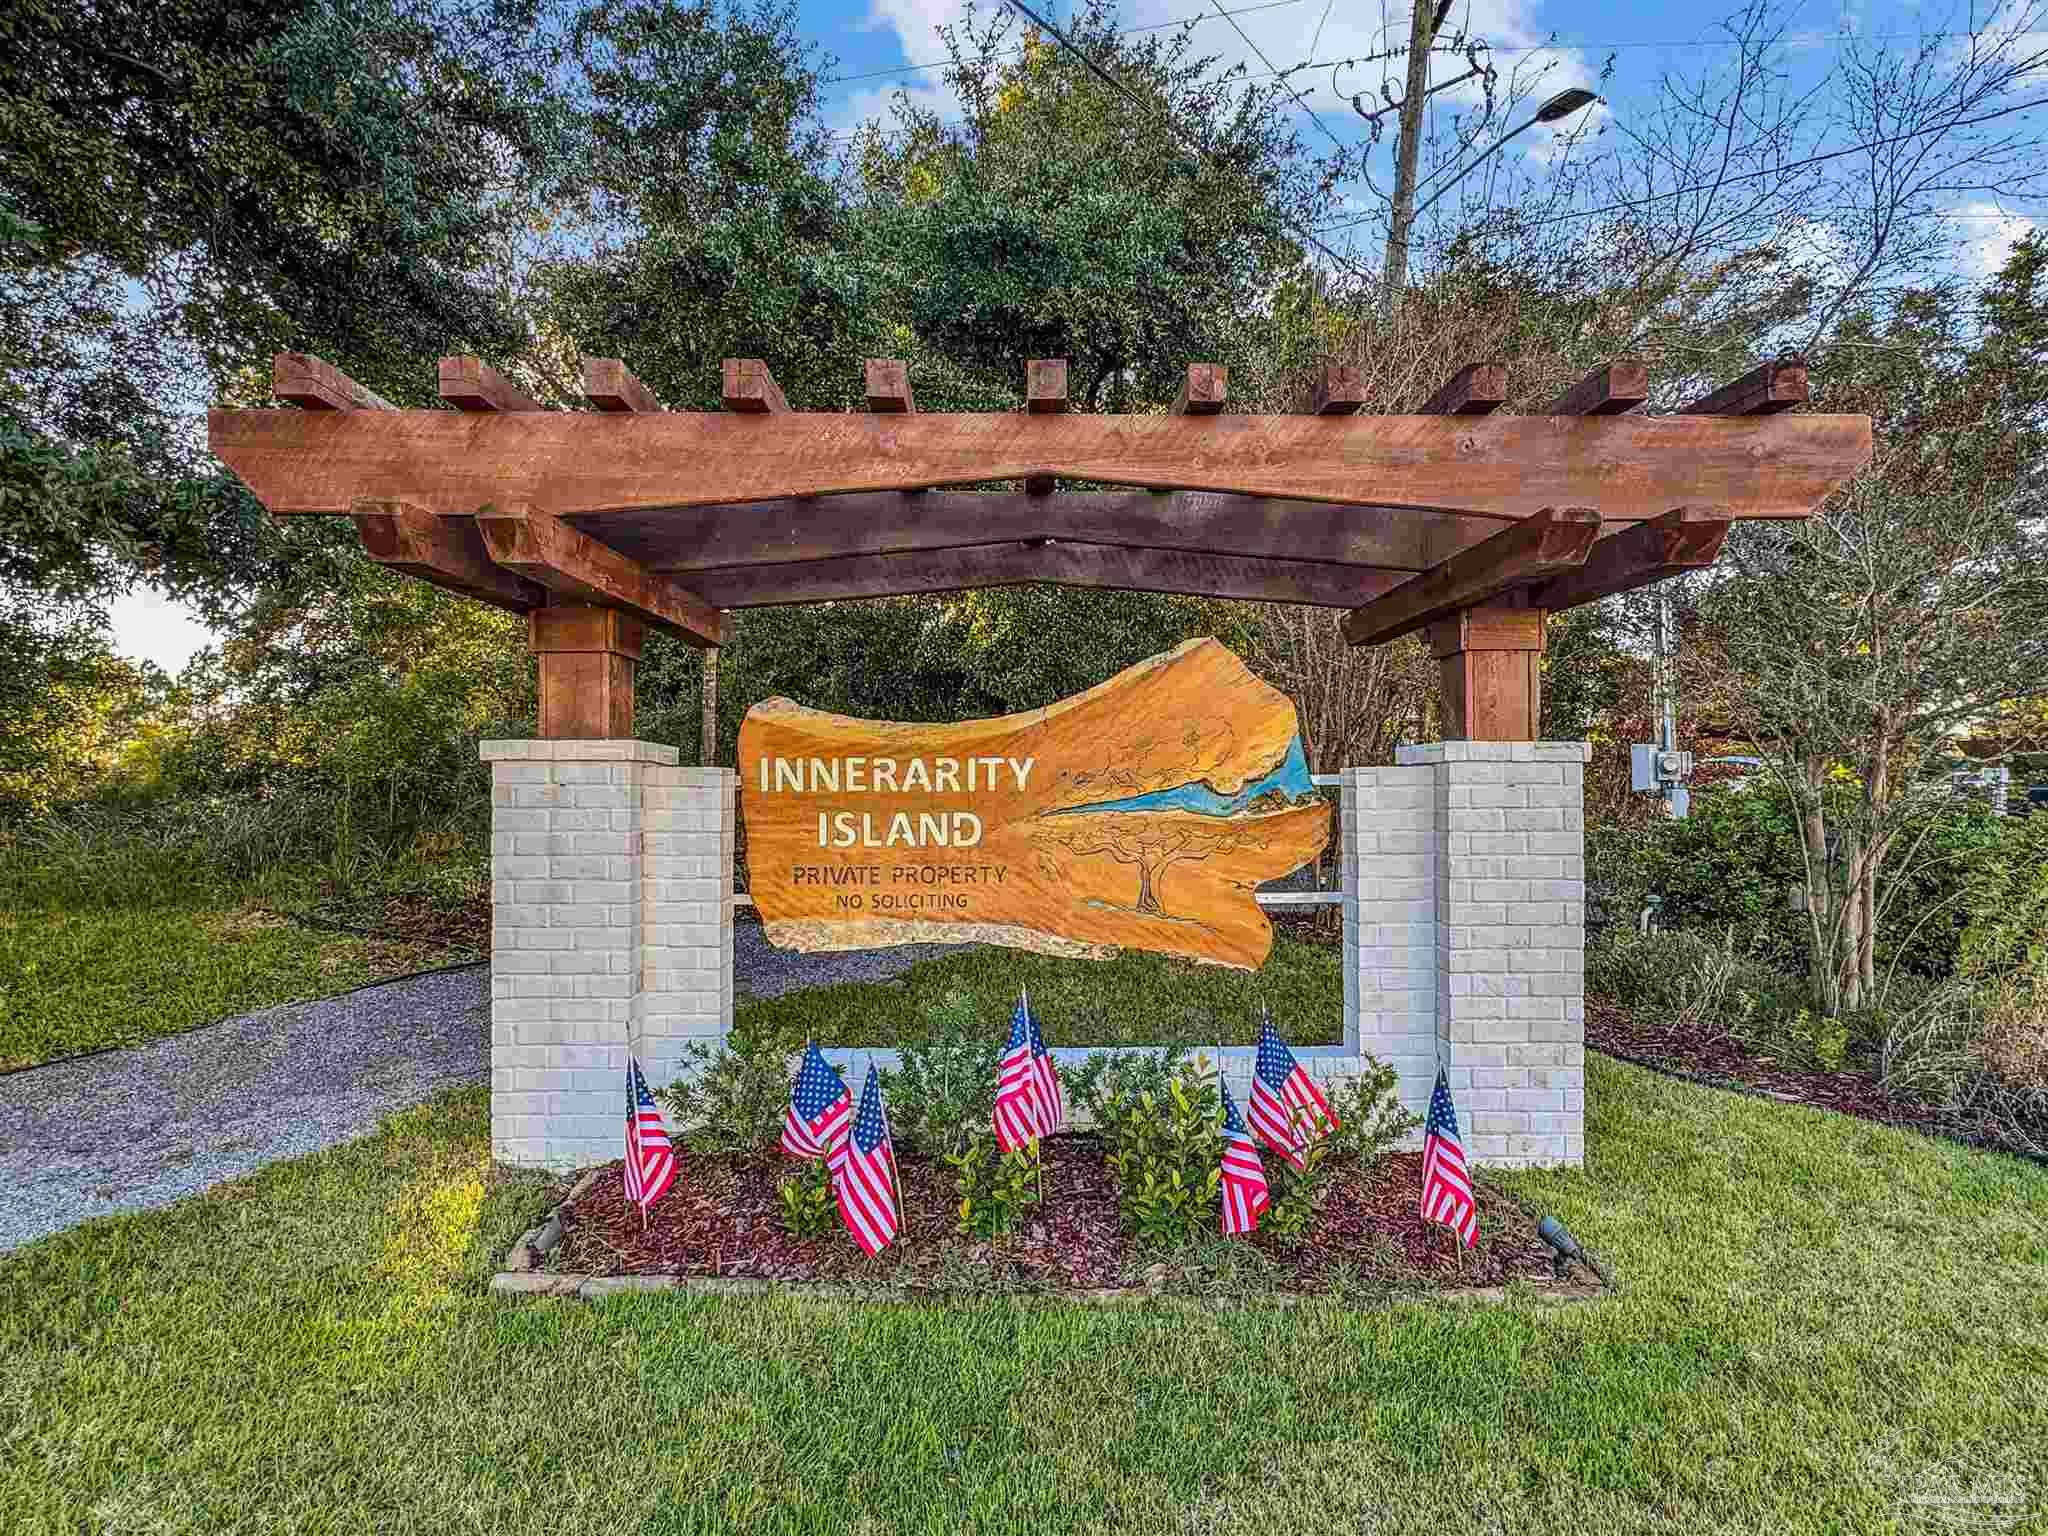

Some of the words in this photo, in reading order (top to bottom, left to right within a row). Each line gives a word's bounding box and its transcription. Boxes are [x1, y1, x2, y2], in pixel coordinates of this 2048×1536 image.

[759, 757, 1036, 792] INNERARITY
[818, 812, 983, 848] ISLAND
[793, 866, 881, 885] PRIVATE
[892, 866, 1008, 885] PROPERTY
[836, 893, 863, 909] NO
[871, 893, 968, 909] SOLICITING
